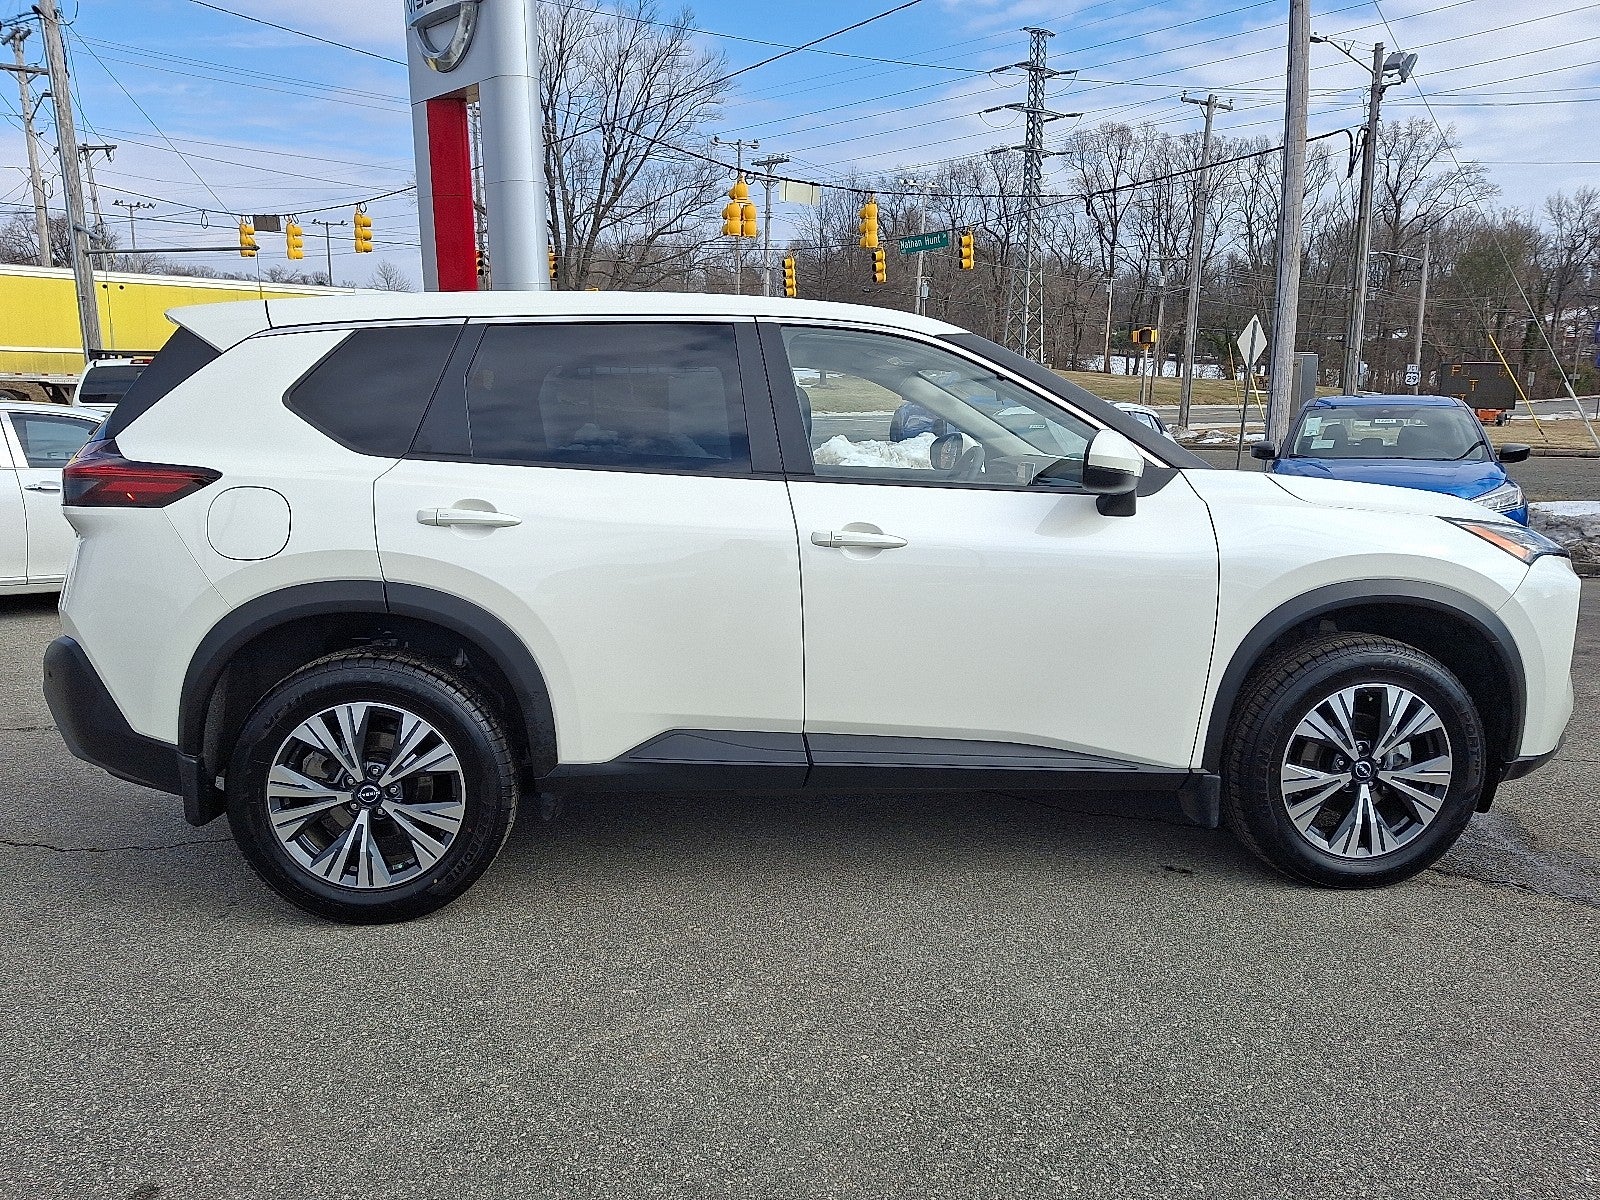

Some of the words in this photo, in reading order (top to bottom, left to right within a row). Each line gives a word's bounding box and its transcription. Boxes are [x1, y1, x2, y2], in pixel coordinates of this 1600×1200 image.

[899, 239, 923, 250] Nathan
[924, 233, 941, 245] Hunt
[1406, 375, 1417, 383] 29
